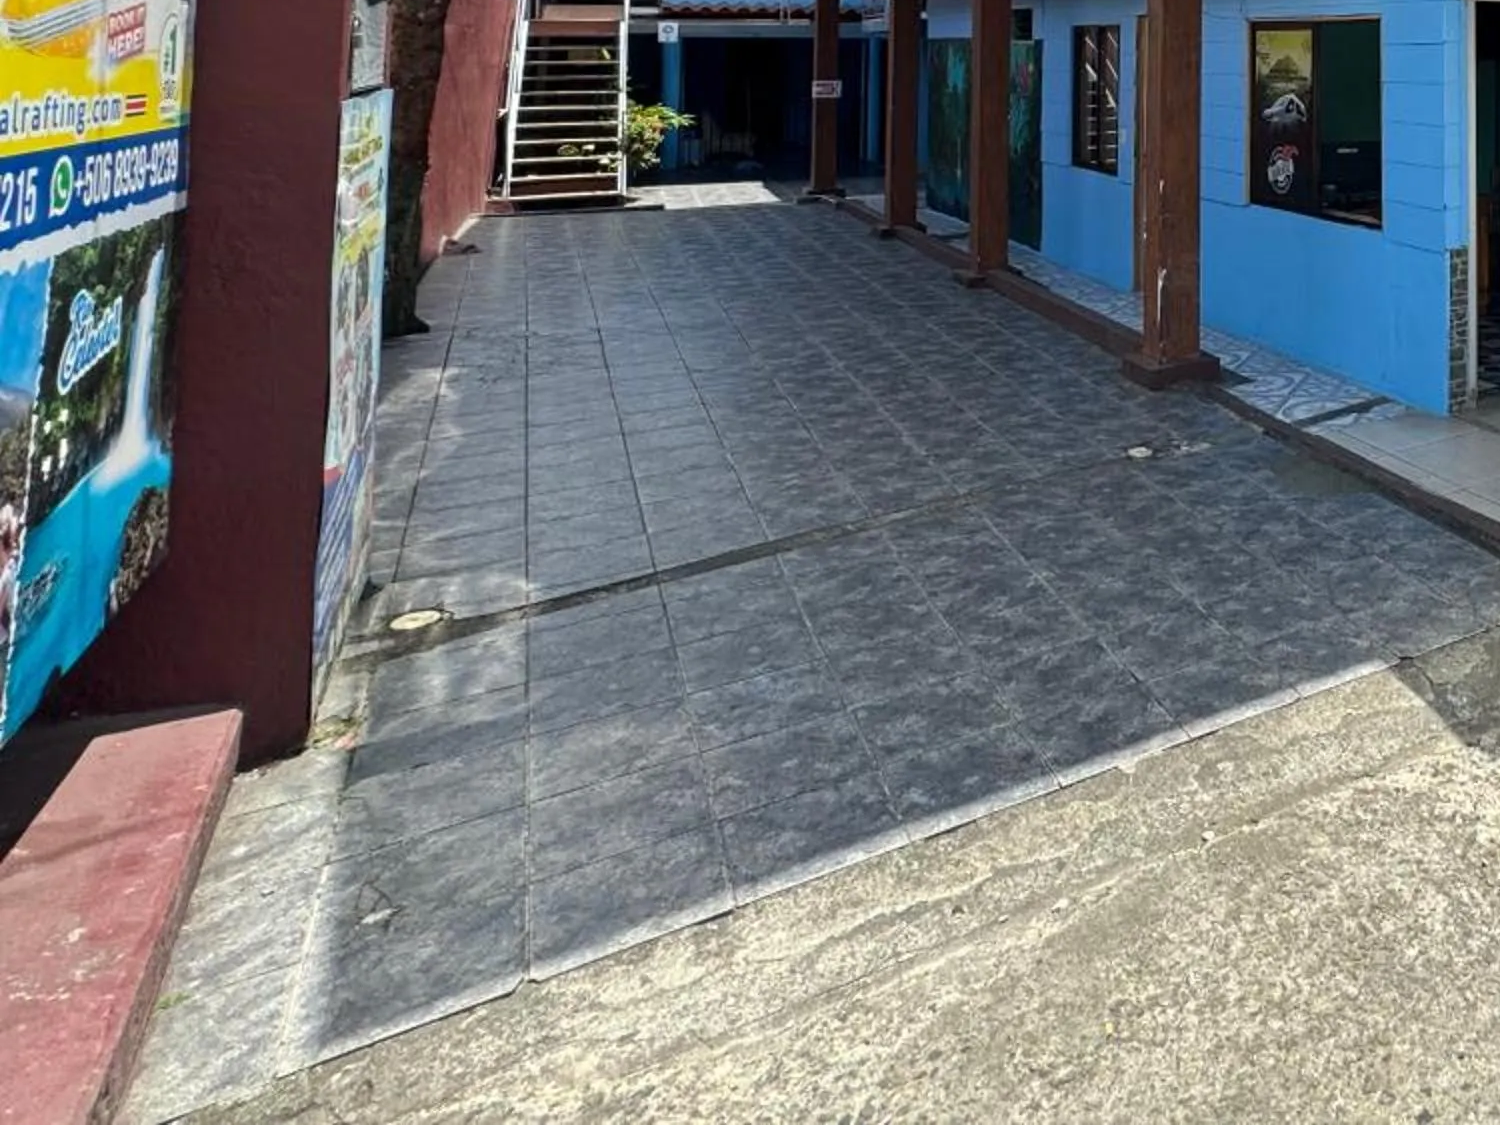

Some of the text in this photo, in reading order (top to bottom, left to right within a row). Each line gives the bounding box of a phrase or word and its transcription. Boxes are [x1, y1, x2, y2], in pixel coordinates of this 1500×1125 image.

[0, 138, 179, 231] 215 +506 8939-9239
